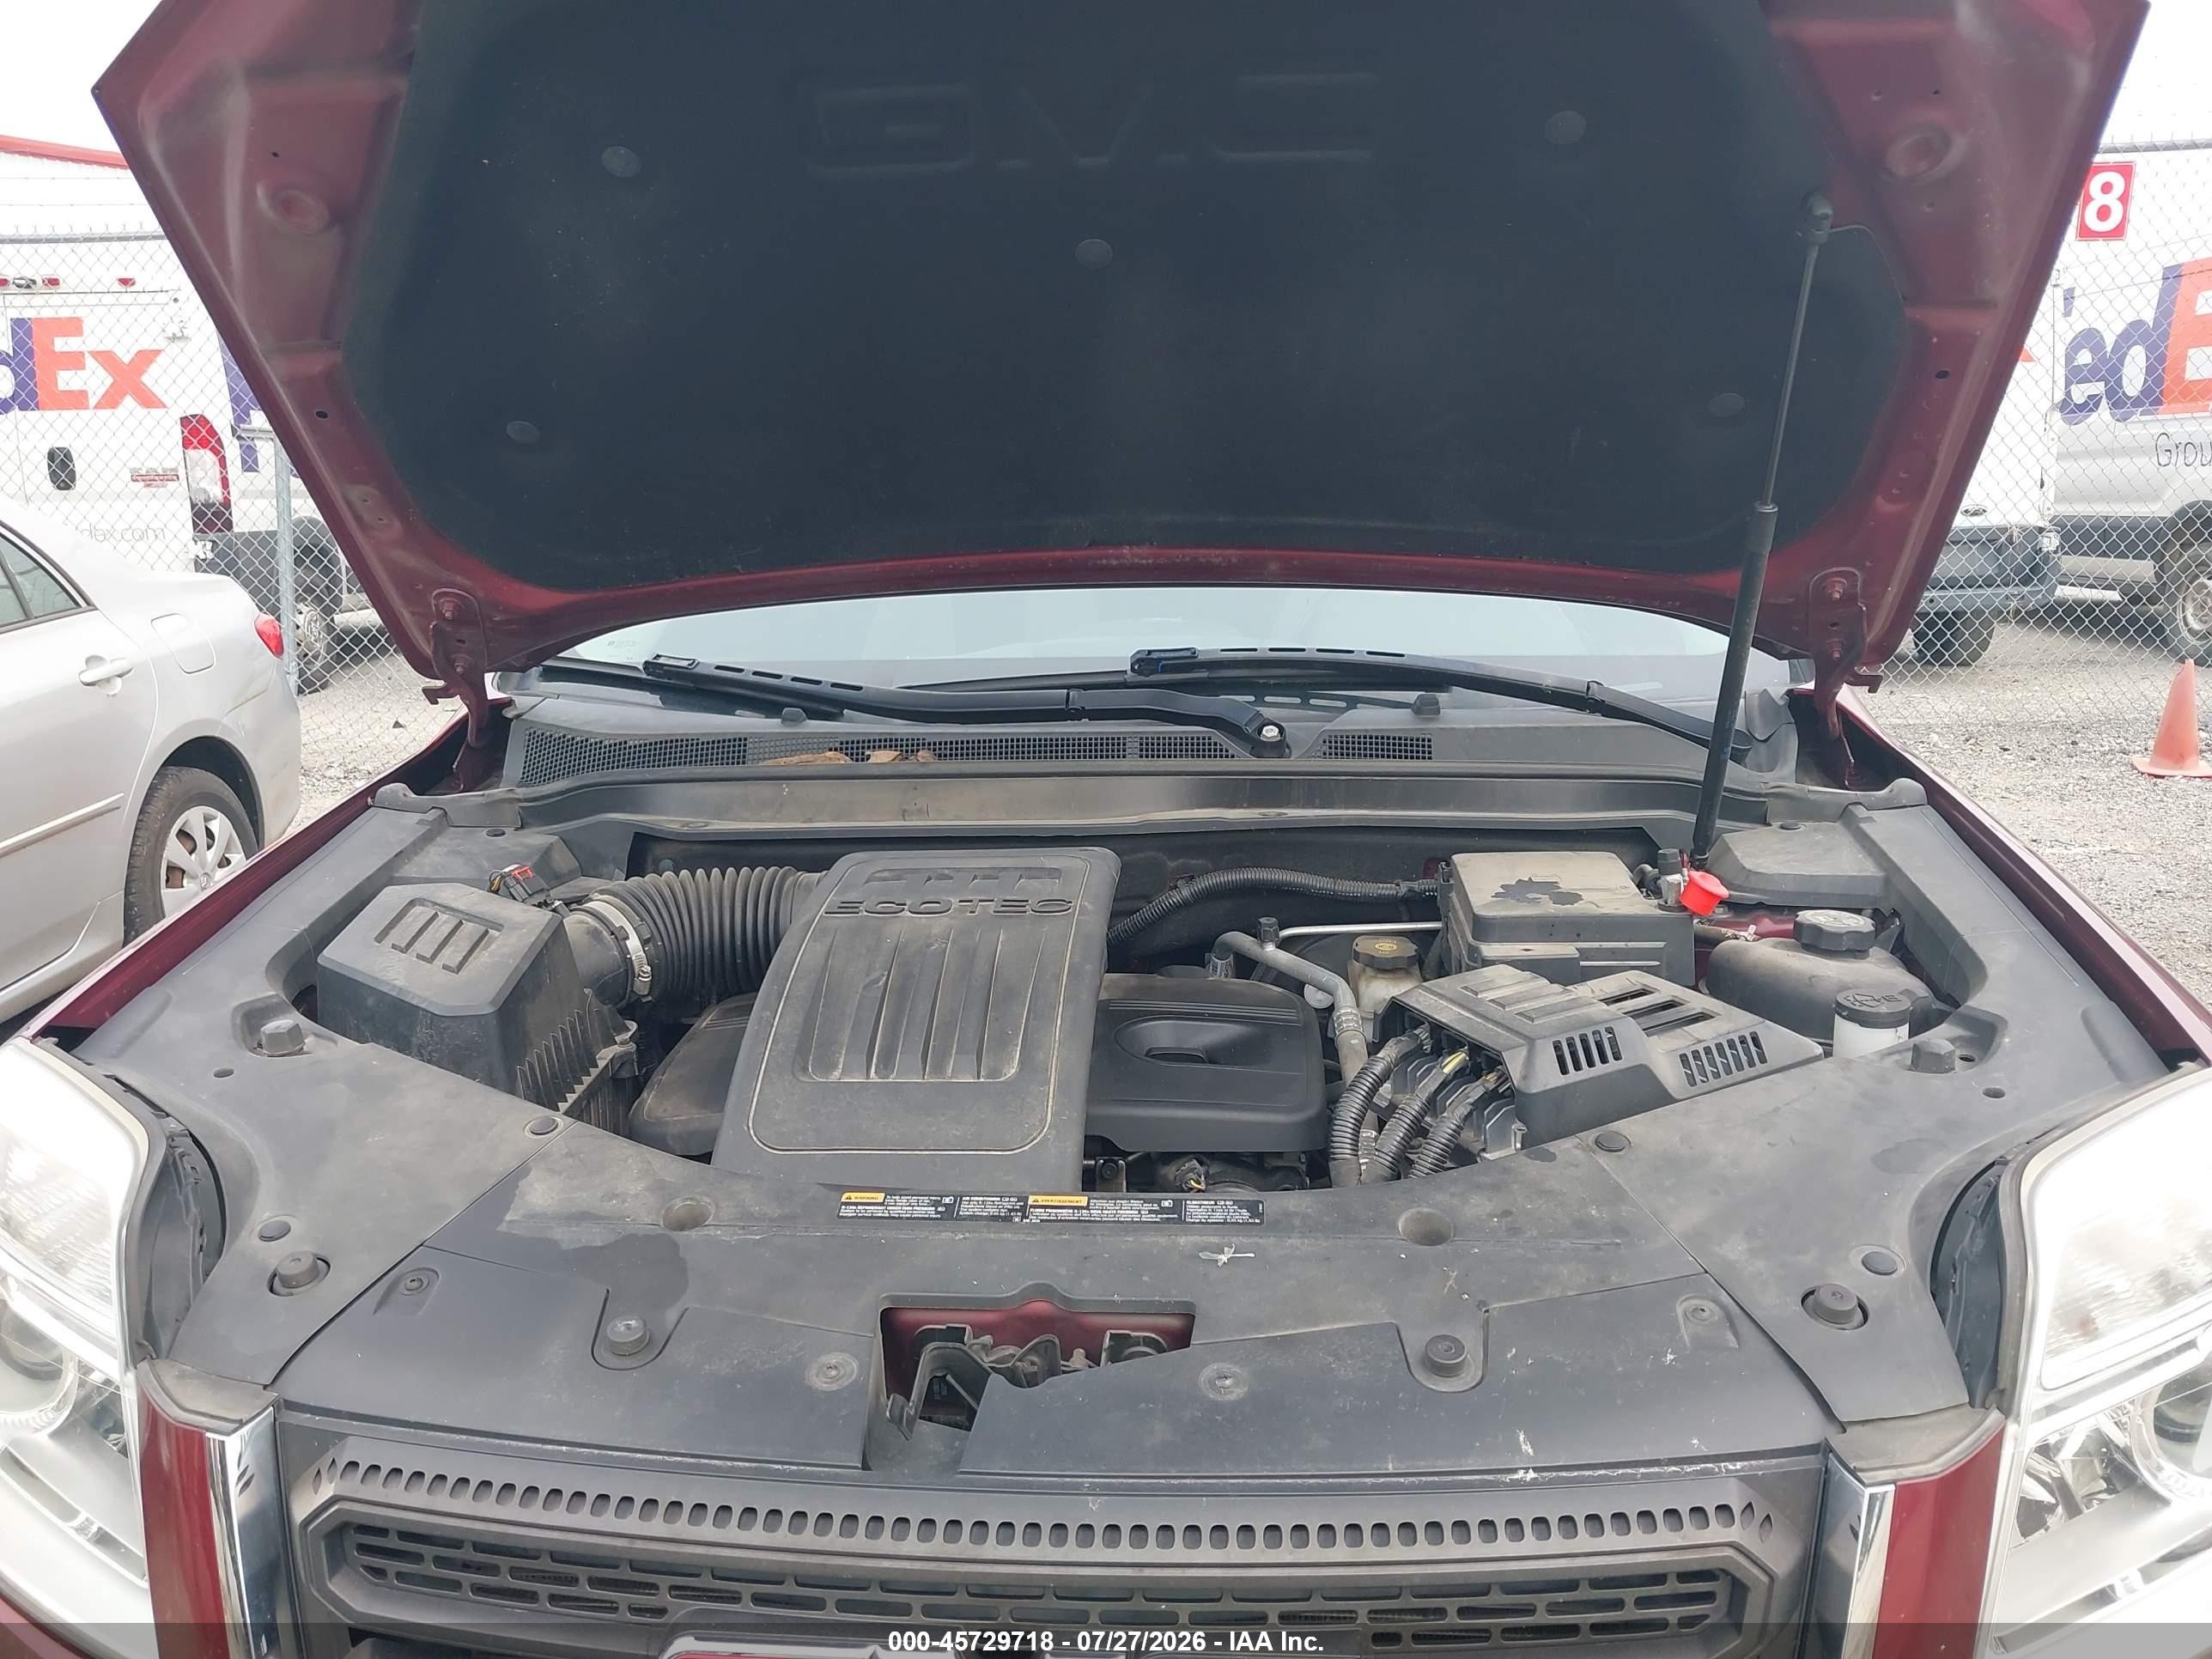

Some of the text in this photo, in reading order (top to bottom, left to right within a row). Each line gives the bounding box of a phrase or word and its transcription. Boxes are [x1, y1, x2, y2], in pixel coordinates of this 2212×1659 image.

[2084, 171, 2126, 233] 8
[2061, 257, 2212, 426] edE
[823, 897, 1073, 917] ECOTEC
